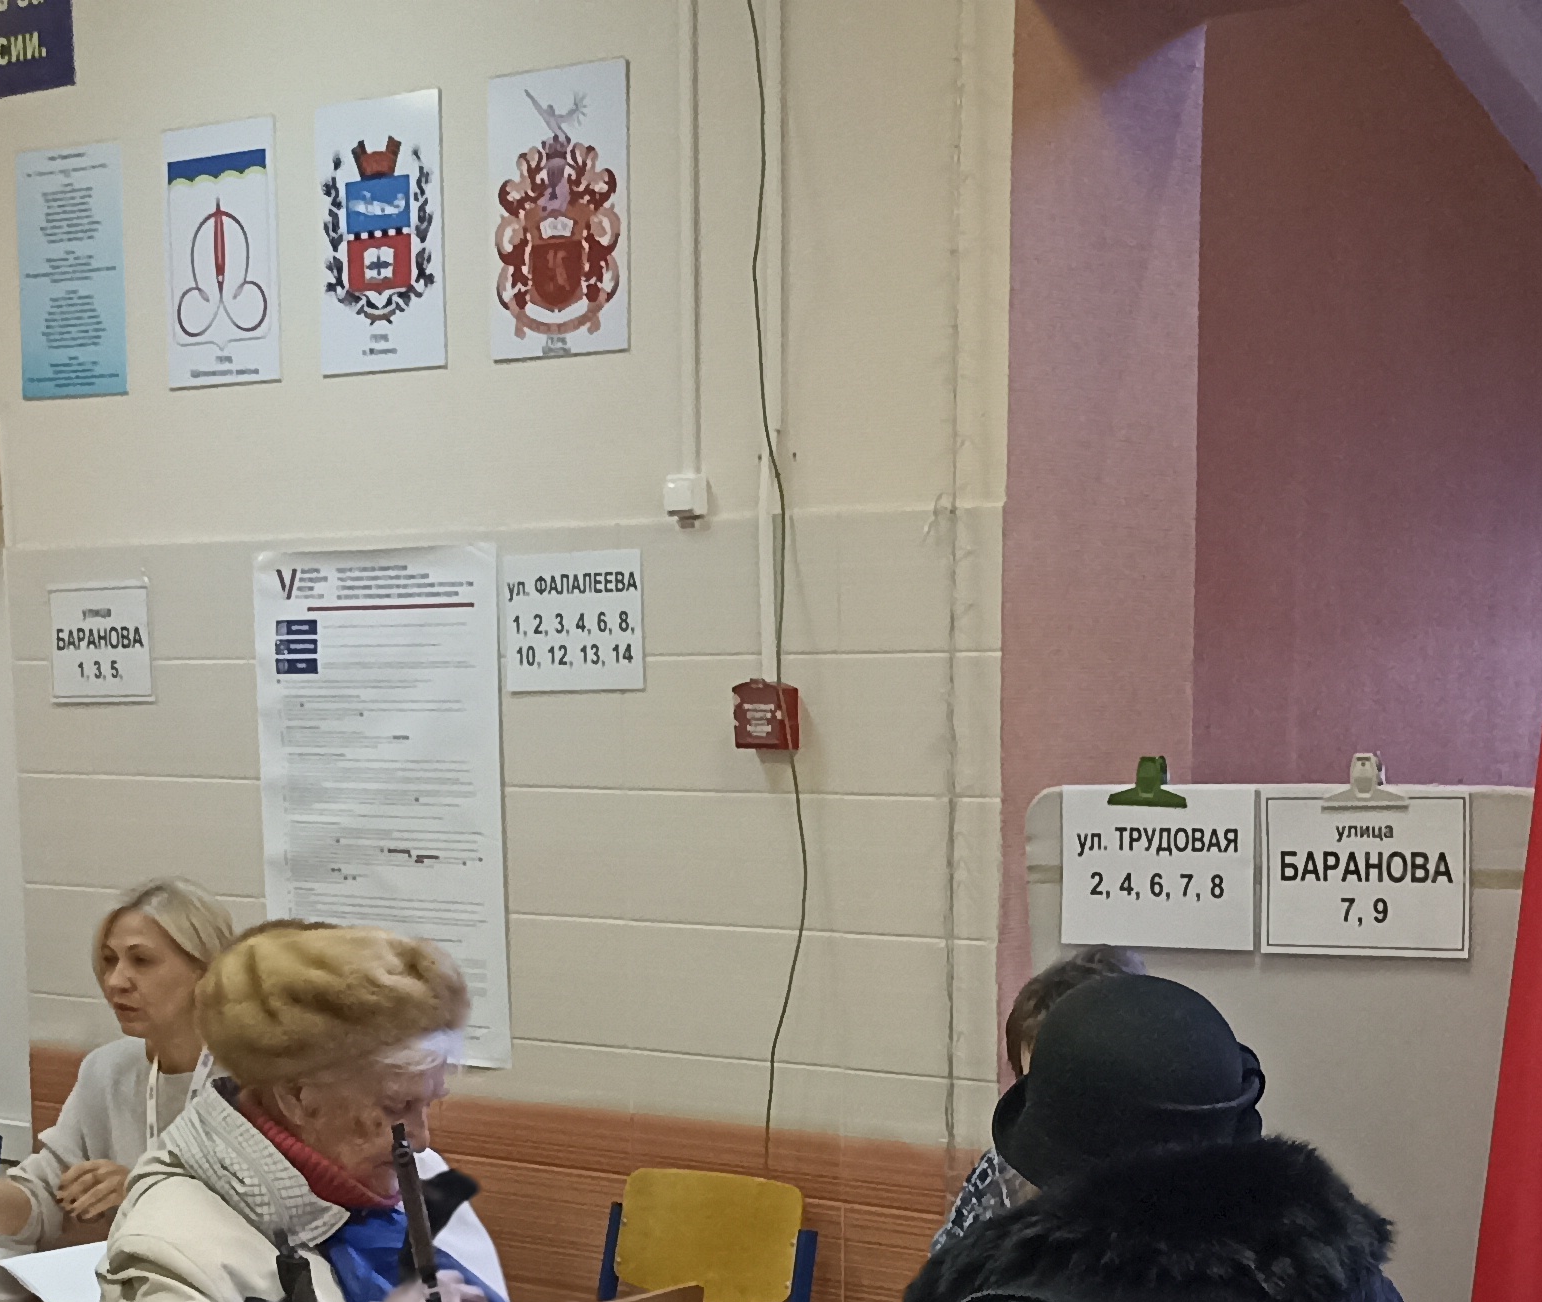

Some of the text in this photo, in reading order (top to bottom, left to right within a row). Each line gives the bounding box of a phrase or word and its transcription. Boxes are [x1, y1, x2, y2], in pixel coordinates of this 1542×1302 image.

[507, 571, 638, 602] ул. ФАЛАЛЕЕВА
[56, 626, 145, 651] БАРАНОВА
[512, 610, 636, 638] 1, 2, 3, 4, 6, 8,
[516, 642, 634, 670] 10, 12, 13, 14
[1076, 826, 1239, 857] ул. ТРУДОВАЯ
[1335, 824, 1394, 842] улица
[1280, 850, 1454, 884] БАРАНОВА
[1089, 871, 1225, 902] 2, 4, 6, 7, 8
[1340, 897, 1389, 928] 7, 9
